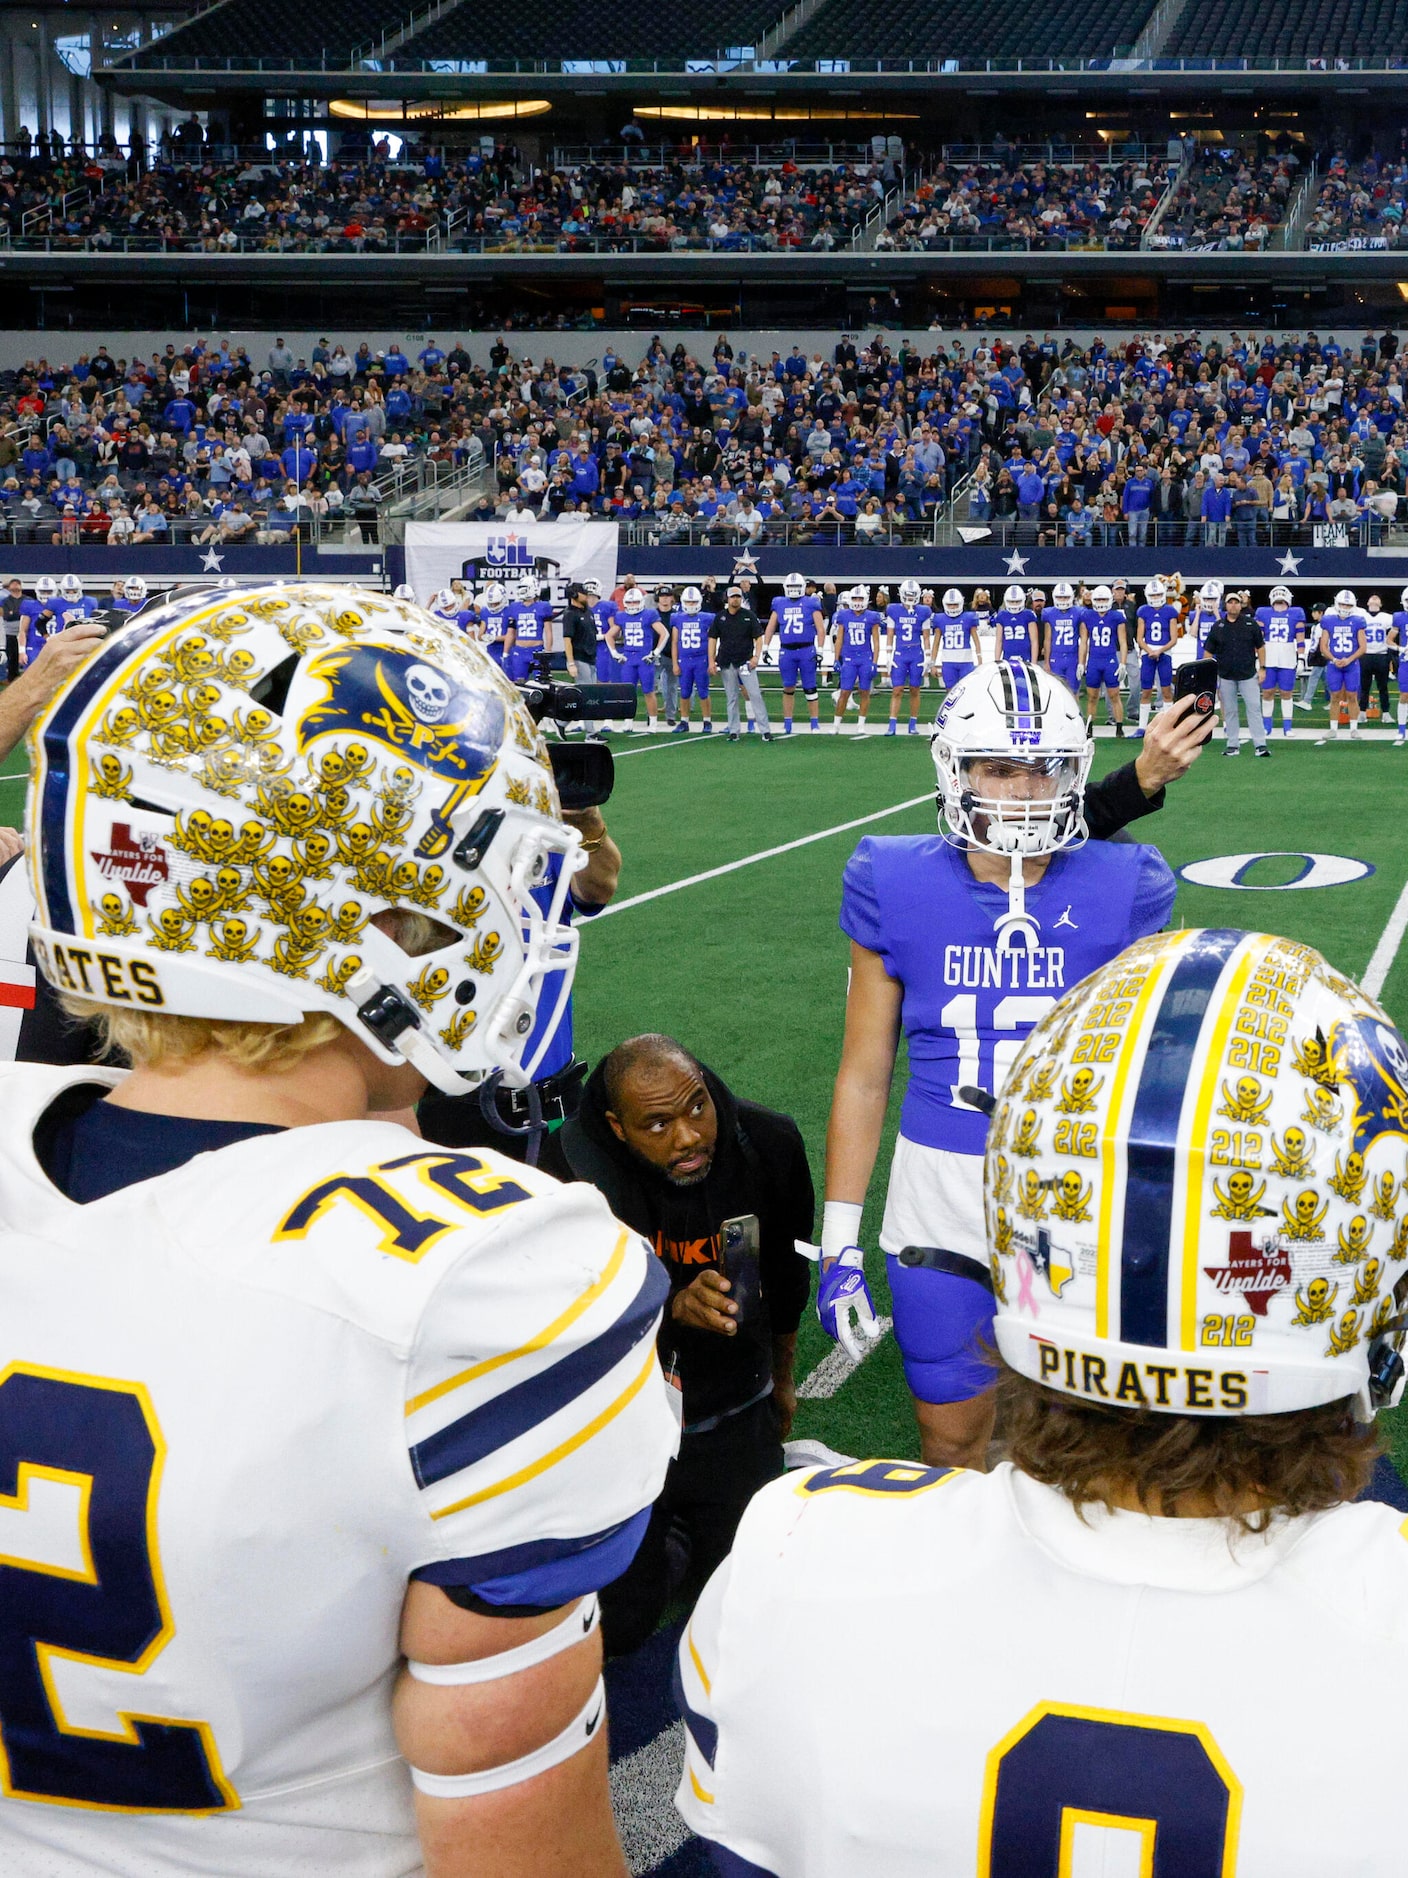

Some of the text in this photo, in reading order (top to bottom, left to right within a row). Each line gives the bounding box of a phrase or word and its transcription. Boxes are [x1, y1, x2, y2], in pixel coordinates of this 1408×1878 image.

[1315, 523, 1345, 538] TEAM
[517, 619, 537, 637] 22
[783, 614, 804, 634] 75
[902, 624, 912, 641] 3
[1004, 625, 1025, 640] 22
[1055, 625, 1074, 646] 72
[1092, 626, 1111, 647] 48
[1151, 621, 1162, 641] 8
[1269, 624, 1289, 643] 23
[625, 629, 644, 646] 52
[681, 629, 701, 648] 65
[848, 629, 866, 646] 10
[1333, 633, 1353, 653] 35
[99, 857, 164, 884] Uvalde
[44, 954, 165, 1006] ATES
[944, 946, 1065, 989] GUNTER
[1097, 976, 1147, 1001] 212
[1082, 1001, 1133, 1031] 212
[1235, 1007, 1289, 1046] 212
[1071, 1033, 1122, 1064] 212
[1227, 1037, 1281, 1079] 212
[1054, 1119, 1098, 1159] 212
[1210, 1129, 1262, 1170] 212
[270, 1151, 536, 1264] 72
[1215, 1268, 1288, 1294] Uvalde
[1201, 1314, 1255, 1347] 212
[1038, 1342, 1249, 1410] PIRATES
